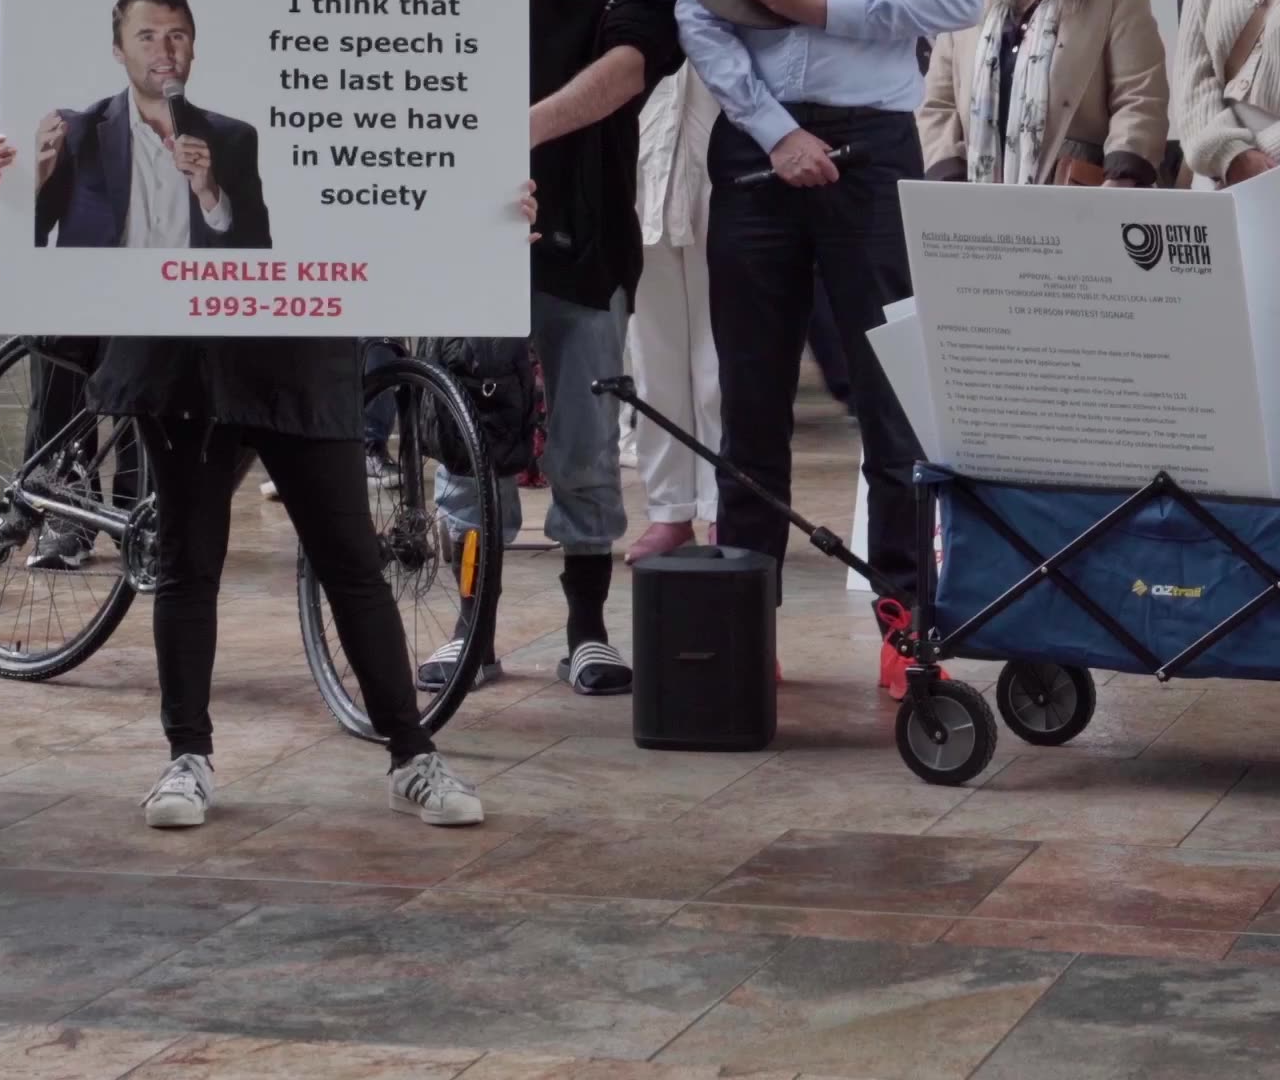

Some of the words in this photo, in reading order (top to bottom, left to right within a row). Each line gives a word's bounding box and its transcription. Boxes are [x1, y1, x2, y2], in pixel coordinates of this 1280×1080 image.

[269, 30, 328, 52] free
[340, 33, 442, 57] speech
[456, 33, 478, 54] is
[280, 69, 328, 89] the
[341, 69, 393, 90] last
[405, 70, 467, 91] best
[271, 106, 342, 132] hope
[354, 113, 396, 128] we
[408, 108, 477, 130] have
[293, 145, 317, 166] in
[330, 146, 454, 167] Western
[321, 184, 427, 210] society
[1166, 224, 1190, 243] CITY
[1194, 225, 1208, 243] OF
[1168, 244, 1211, 265] PERTH
[161, 261, 286, 281] CHARLIE
[298, 262, 368, 281] KIRK
[1194, 267, 1211, 275] Light
[189, 297, 342, 316] 1993-2025
[1033, 308, 1064, 316] PERSON
[1065, 309, 1098, 318] PROTEST
[1100, 311, 1135, 320] SIGNAGE
